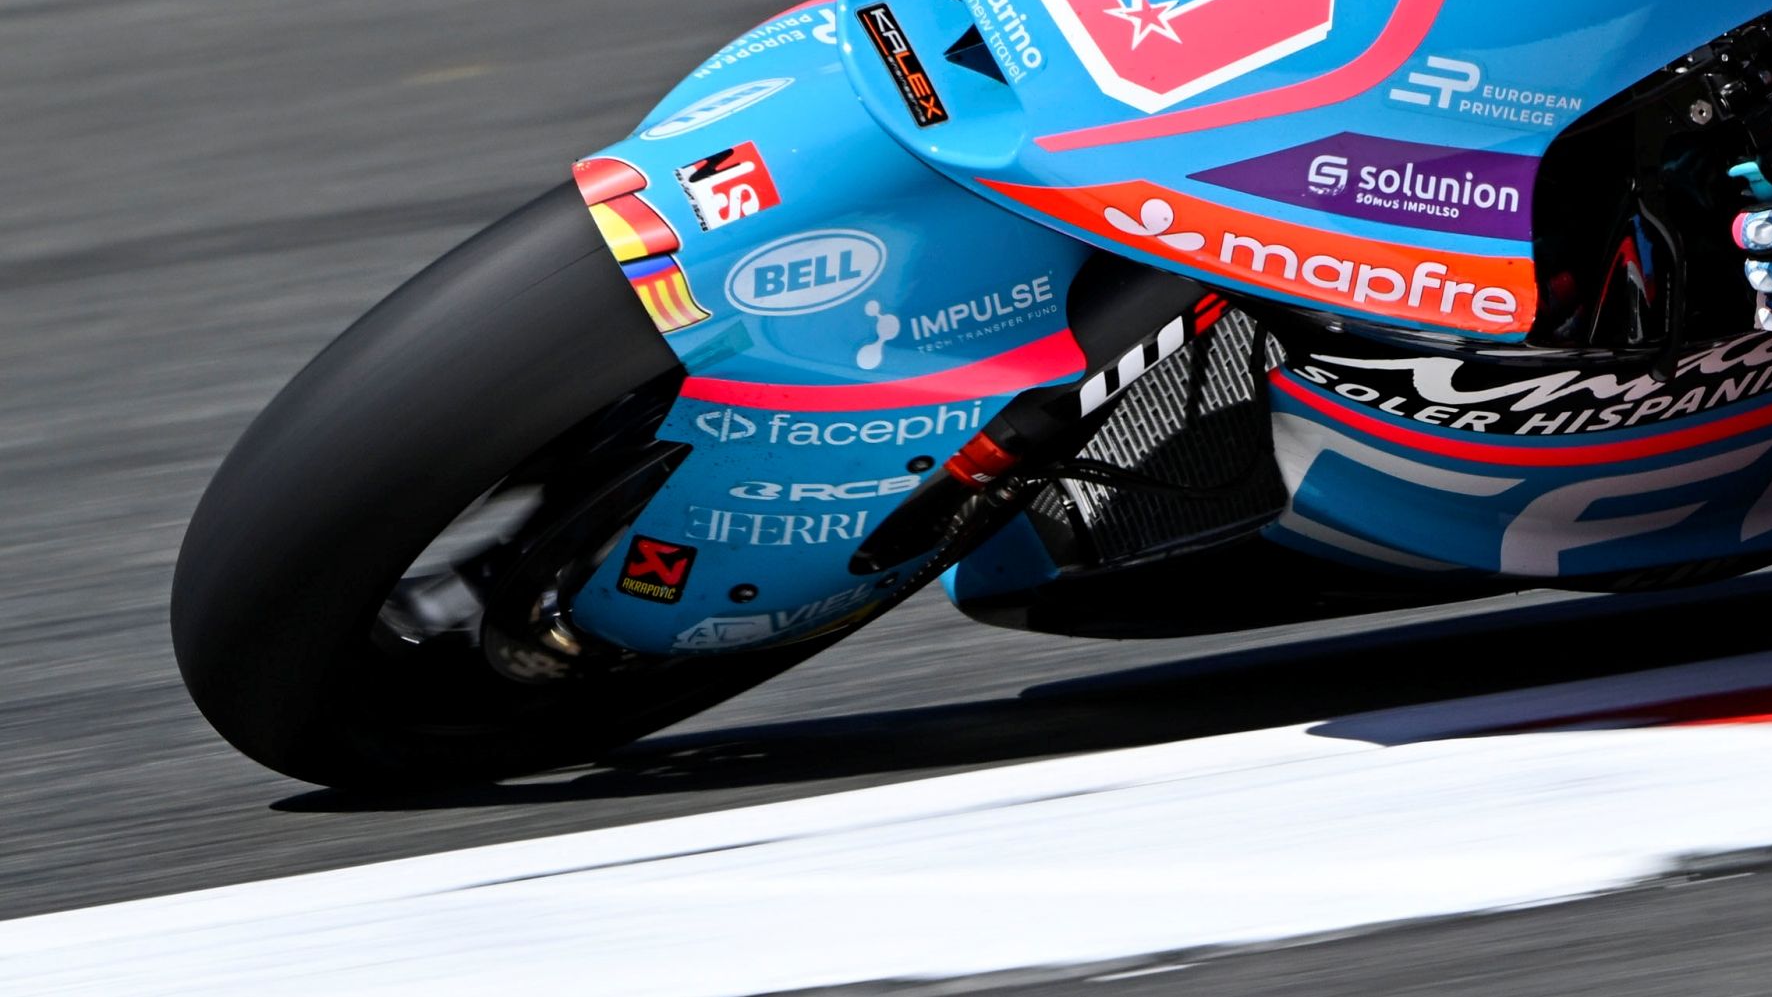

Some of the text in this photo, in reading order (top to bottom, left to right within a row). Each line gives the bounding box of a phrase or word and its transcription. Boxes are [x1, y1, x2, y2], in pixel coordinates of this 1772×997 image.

[694, 29, 806, 79] EUROPEAN
[870, 8, 942, 119] KALEX
[990, 34, 1027, 85] travel
[1458, 99, 1554, 127] PRIVILEGE
[1482, 84, 1582, 112] EUROPEAN
[1356, 162, 1519, 213] solunion
[1403, 198, 1459, 219] IMPULSO
[753, 250, 861, 299] BELL
[1219, 231, 1517, 324] mapfre
[910, 276, 1053, 341] IMPULSE
[918, 304, 1057, 354] TECH TRANSFER FUND
[768, 401, 983, 445] facephi
[1293, 364, 1500, 433] SOLER
[790, 475, 922, 501] RCB
